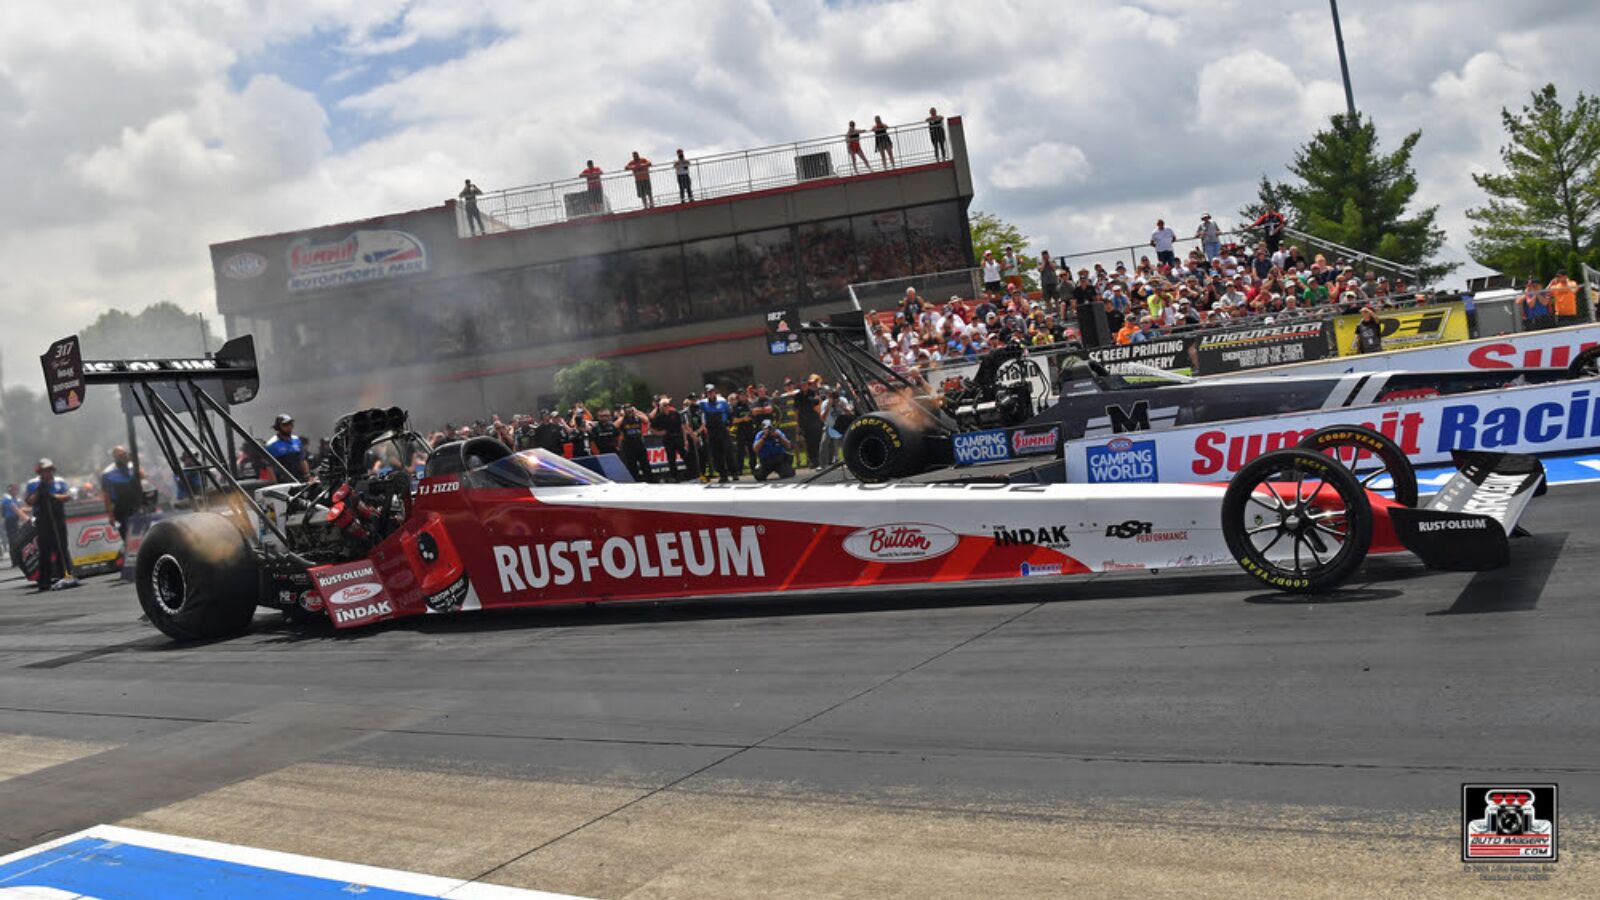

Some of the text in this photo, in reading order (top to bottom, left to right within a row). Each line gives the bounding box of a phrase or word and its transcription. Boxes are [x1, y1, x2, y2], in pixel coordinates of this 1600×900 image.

[1201, 322, 1322, 344] LINGENFELTER
[1089, 346, 1130, 362] SCREEN
[1132, 340, 1183, 358] PRINTING
[1105, 400, 1151, 434] M
[954, 432, 1006, 449] CAMPING
[956, 445, 1008, 461] WORLD
[1090, 450, 1152, 467] CAMPING
[1091, 463, 1153, 482] WORLD
[420, 481, 460, 495] TJ ZIZZO
[1419, 518, 1487, 532] RUST-OLEUM
[868, 526, 931, 553] Button
[994, 525, 1069, 546] INDAK
[1136, 531, 1188, 543] PERFORMANCE
[493, 525, 766, 593] RUST-OLEUM
[320, 567, 373, 587] RUST-OLEUM
[336, 601, 393, 623] INDAK
